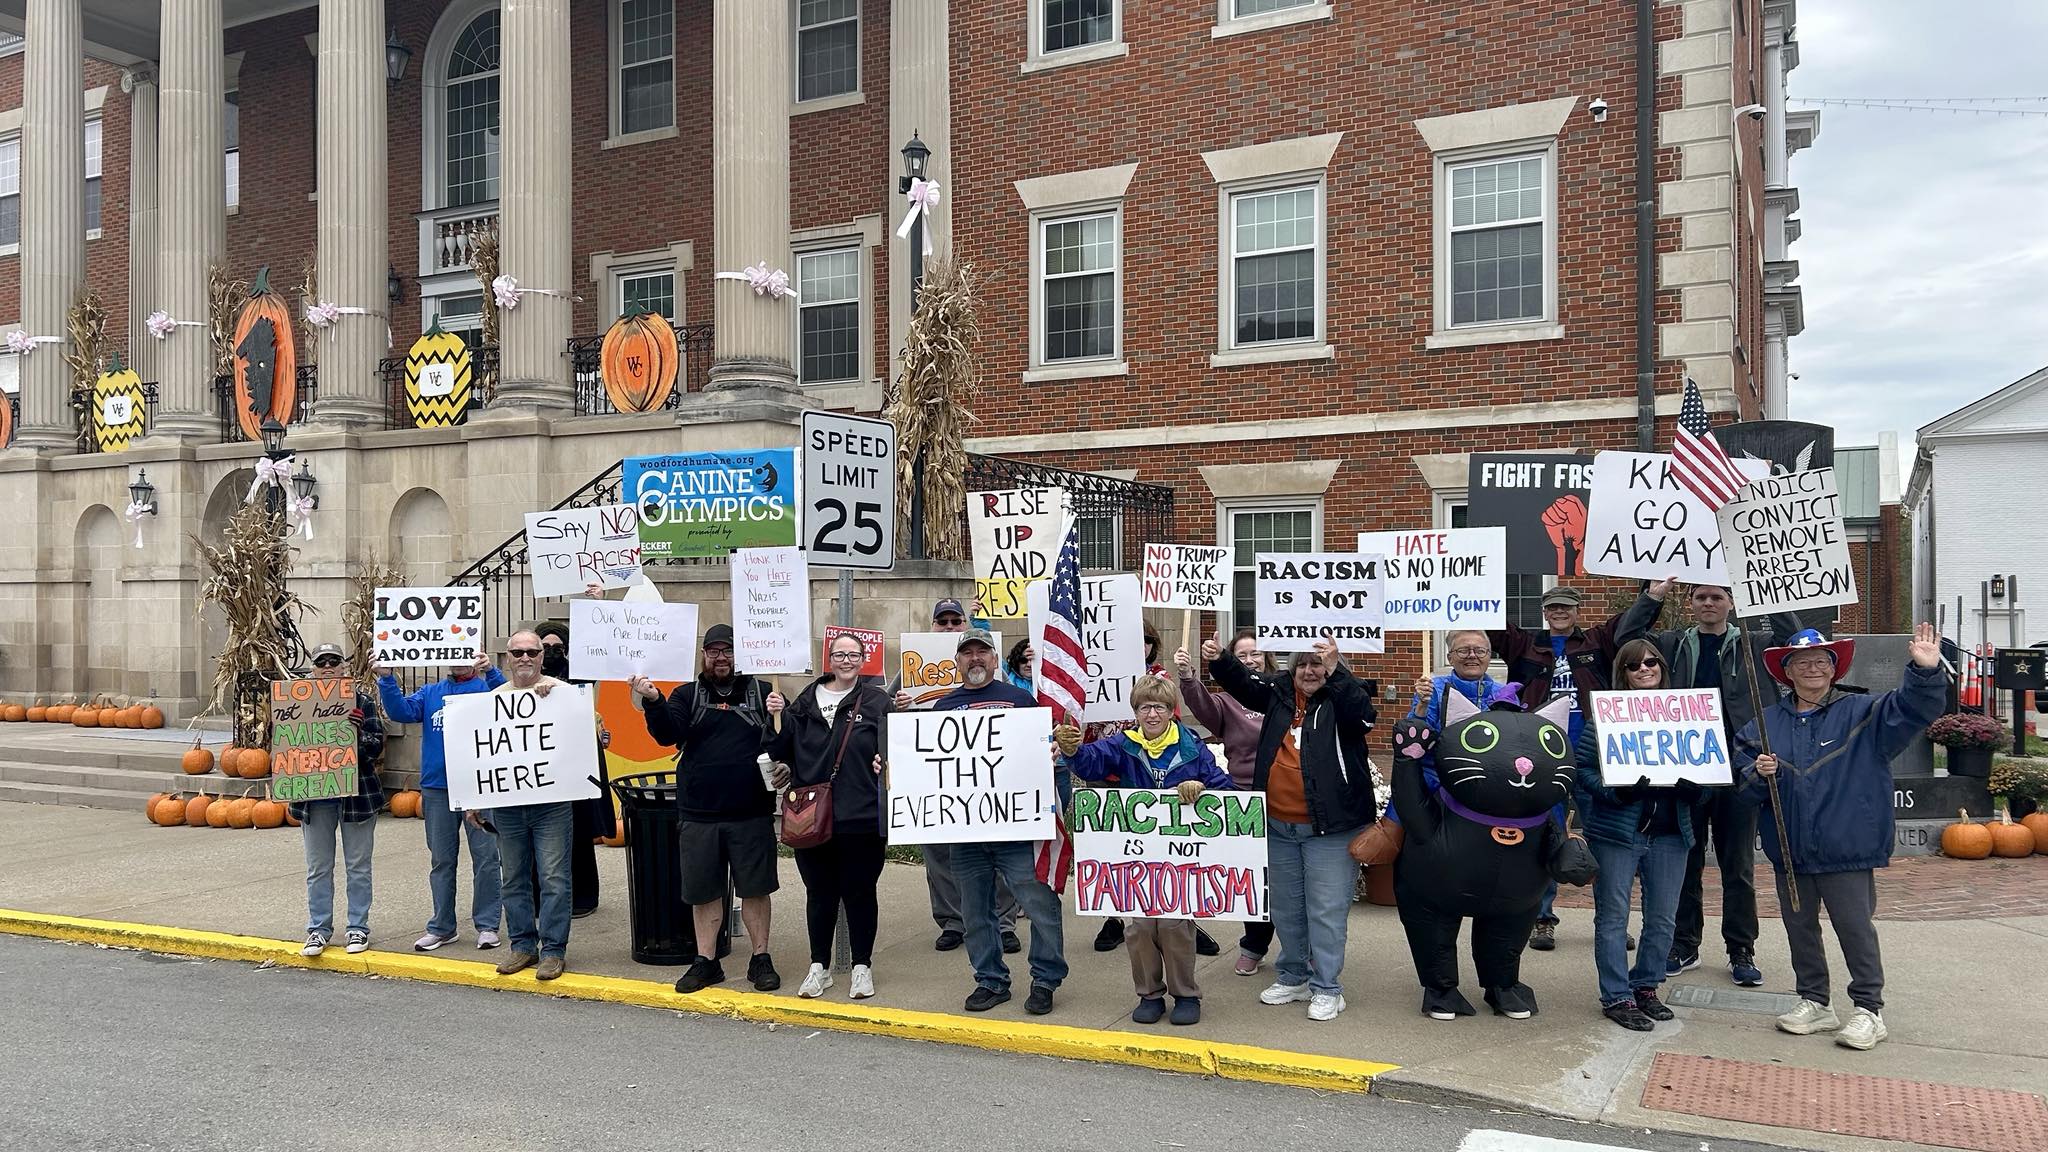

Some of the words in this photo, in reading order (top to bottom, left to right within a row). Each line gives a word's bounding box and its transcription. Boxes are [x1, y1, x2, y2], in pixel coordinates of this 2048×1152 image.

[811, 429, 888, 459] SPEED
[639, 456, 755, 468] woodfordhumane.org
[822, 462, 879, 489] LIMIT
[1482, 463, 1545, 488] FIGHT
[1554, 464, 1594, 489] FAS
[1629, 458, 1680, 490] KK
[637, 468, 754, 497] CANINE
[637, 491, 784, 527] OLYMPICS
[980, 489, 1049, 517] RISE
[1634, 499, 1687, 531] GO
[1732, 494, 1838, 533] CONVICT
[533, 517, 590, 553] SAY
[600, 507, 636, 536] NO
[687, 525, 720, 539] presented
[722, 525, 734, 539] by
[812, 498, 883, 556] 25
[995, 525, 1032, 550] UP
[1742, 521, 1838, 557] REMOVE
[641, 541, 672, 550] ECKERT
[1148, 546, 1171, 561] NO
[1176, 546, 1227, 564] TRUMP
[1396, 534, 1449, 556] HATE
[1598, 533, 1721, 570] AWAY
[537, 554, 571, 570] TO
[578, 547, 641, 583] RACISM
[990, 551, 1046, 579] AND
[1146, 562, 1172, 578] NO
[1177, 563, 1216, 580] KKK
[1258, 561, 1377, 580] RACISM
[1384, 558, 1400, 579] AS
[1408, 557, 1434, 578] NO
[1442, 555, 1487, 578] HOME
[1746, 549, 1823, 579] ARREST
[1144, 580, 1171, 603] NO
[1176, 581, 1228, 597] FASCIST
[1275, 591, 1293, 604] IS
[1417, 580, 1430, 591] IN
[1741, 564, 1849, 607] IMPRISON
[375, 596, 481, 621] LOVE
[1084, 603, 1117, 625] N'T
[1188, 593, 1216, 607] USA
[1385, 598, 1441, 614] ODFORD
[402, 629, 443, 642] ONE
[1086, 629, 1116, 651] KE
[1258, 625, 1381, 639] PATRIOTISM
[376, 647, 474, 661] ANOTHER
[1086, 654, 1103, 677] S
[272, 678, 355, 701] LOVE
[273, 706, 302, 720] not
[312, 702, 349, 717] hate
[495, 691, 536, 722] NO
[1596, 693, 1719, 724] REIMAGINE
[273, 719, 356, 747] MAKES
[474, 723, 555, 758] HATE
[915, 713, 1005, 753] LOVE
[272, 747, 356, 775] AMERICA
[1607, 728, 1726, 767] AMERICA
[272, 768, 355, 801] GREAT
[477, 761, 555, 795] HERE
[925, 756, 1004, 789] THY
[891, 789, 1041, 829] EVERYONE!
[1073, 789, 1265, 838] RACISM
[1168, 841, 1207, 857] NOT
[1077, 859, 1268, 921] PATRIOTISM!
